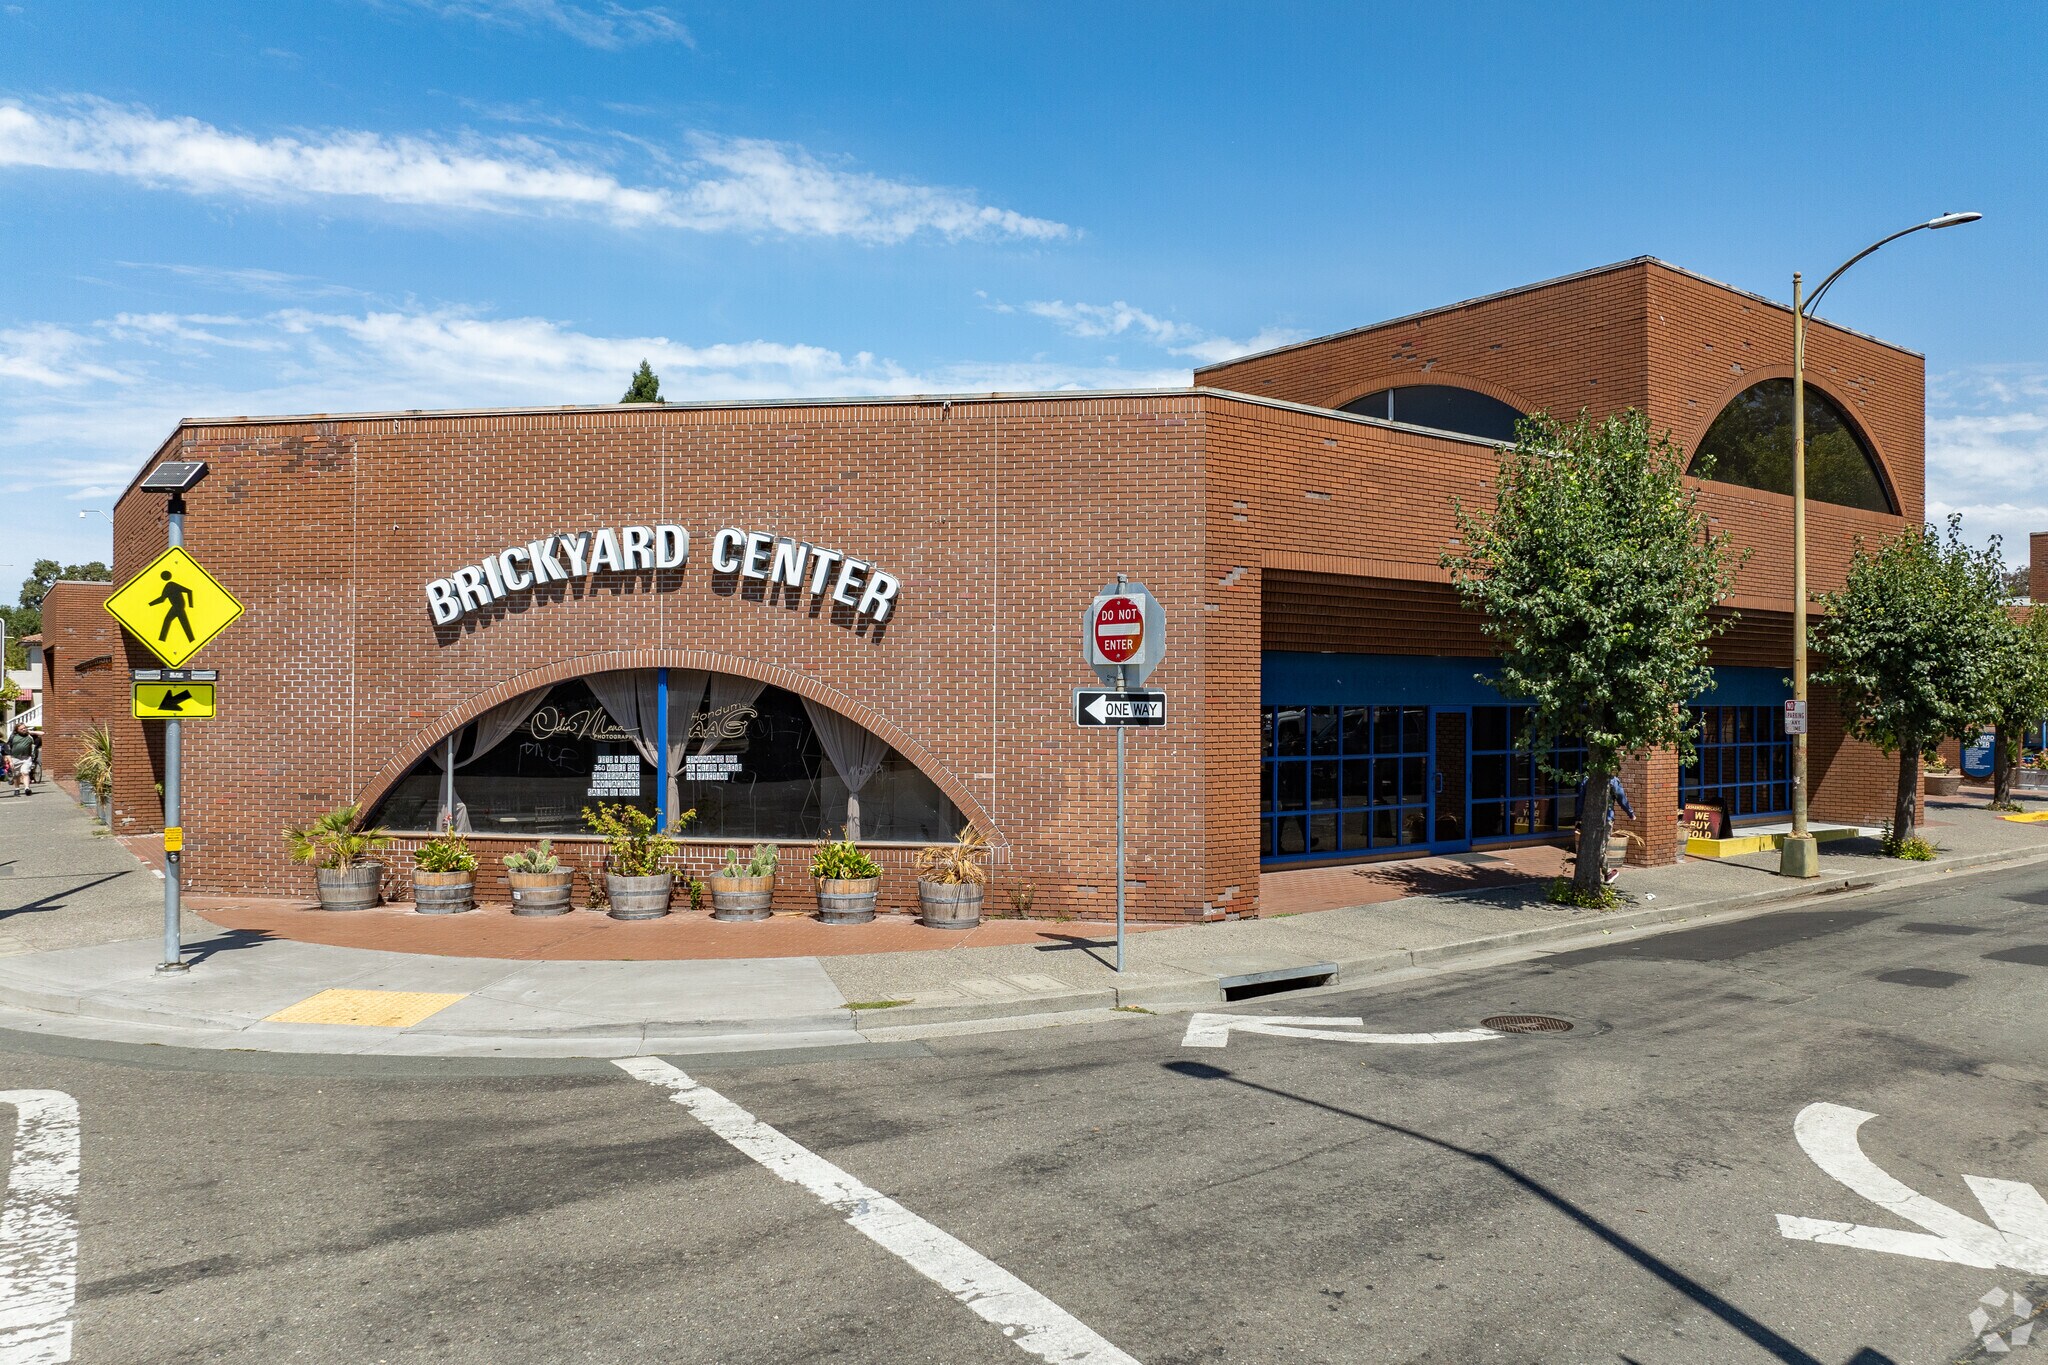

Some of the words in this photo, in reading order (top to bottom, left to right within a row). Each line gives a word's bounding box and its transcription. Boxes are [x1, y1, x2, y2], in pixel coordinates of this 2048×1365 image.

[425, 523, 690, 626] BRICKYARD
[711, 527, 901, 622] CENTER
[1101, 610, 1114, 621] DO
[1118, 608, 1137, 620] NOT
[1104, 639, 1133, 651] ENTER
[1106, 702, 1129, 716] ONE
[1133, 703, 1157, 716] WAY
[1787, 702, 1794, 710] NO
[1694, 811, 1710, 821] WE
[1690, 820, 1711, 830] BUY
